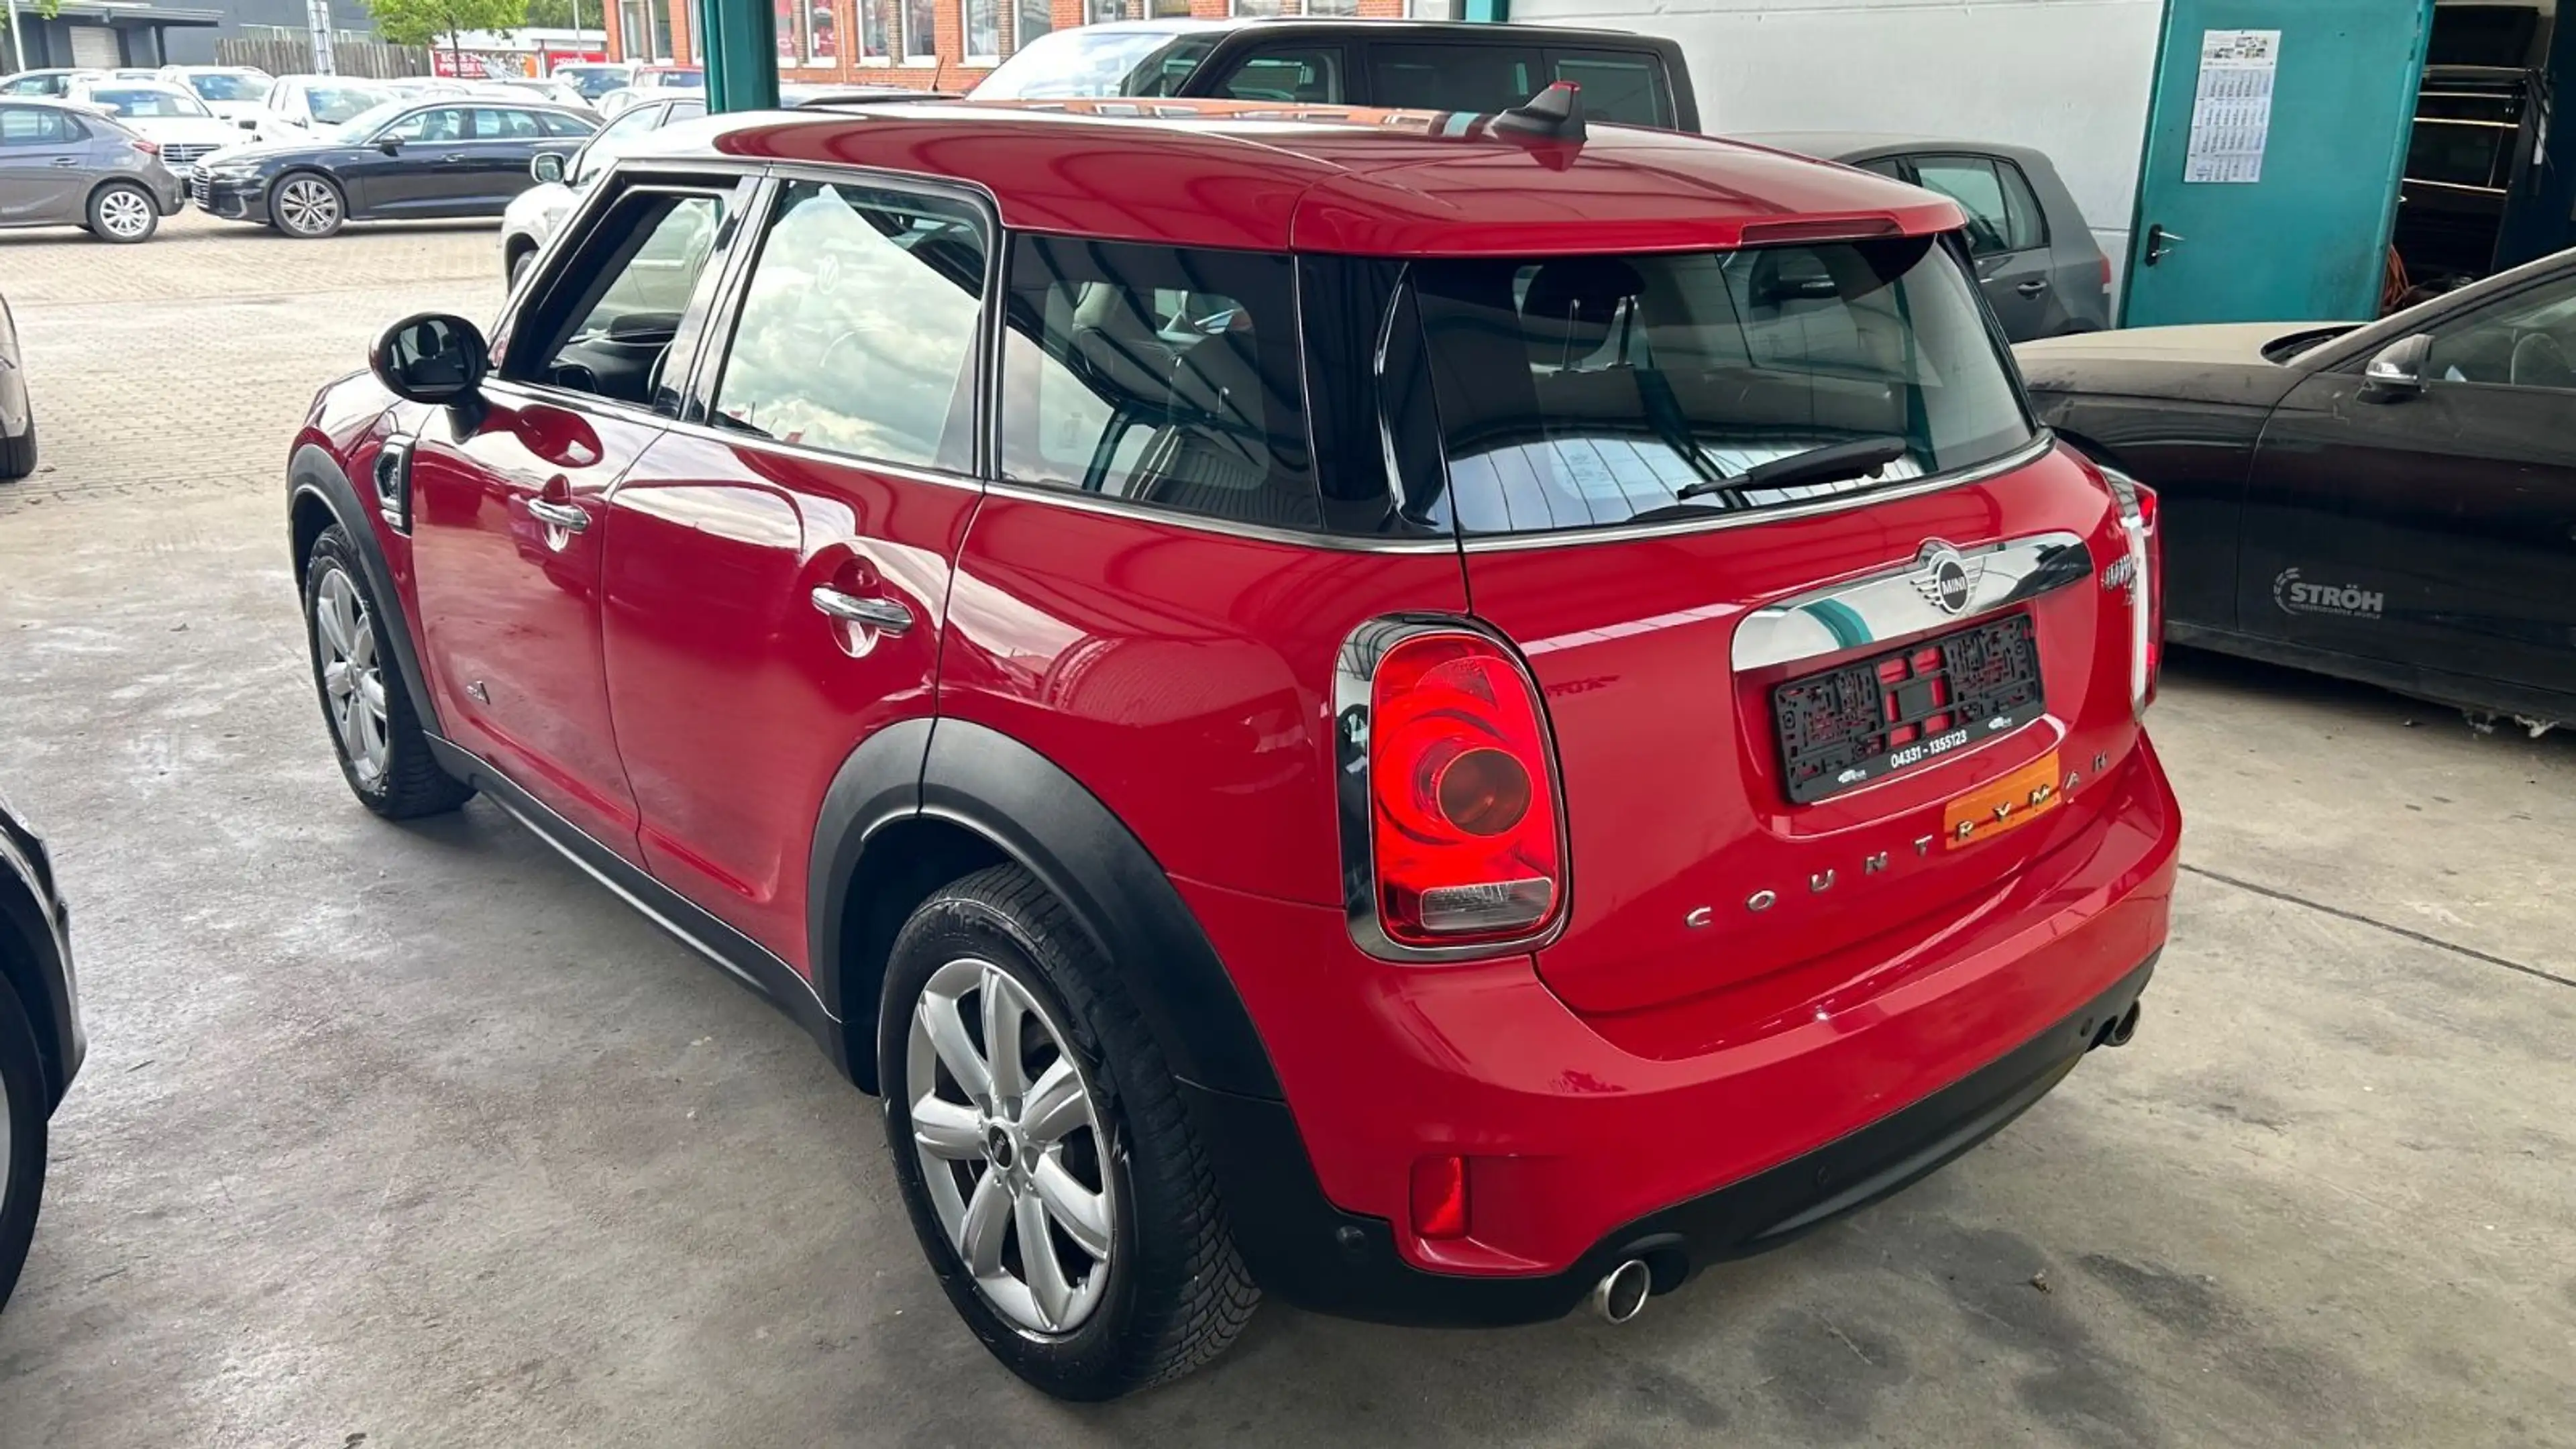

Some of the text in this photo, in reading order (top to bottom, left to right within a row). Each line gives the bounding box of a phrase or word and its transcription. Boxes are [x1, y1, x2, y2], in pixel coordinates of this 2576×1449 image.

[1941, 576, 1967, 595] MINI
[2290, 582, 2383, 611] STRÖH
[1890, 745, 1921, 769] 04331
[1929, 729, 1967, 755] 1355123
[1684, 751, 2107, 928] COUNTRYMAN
